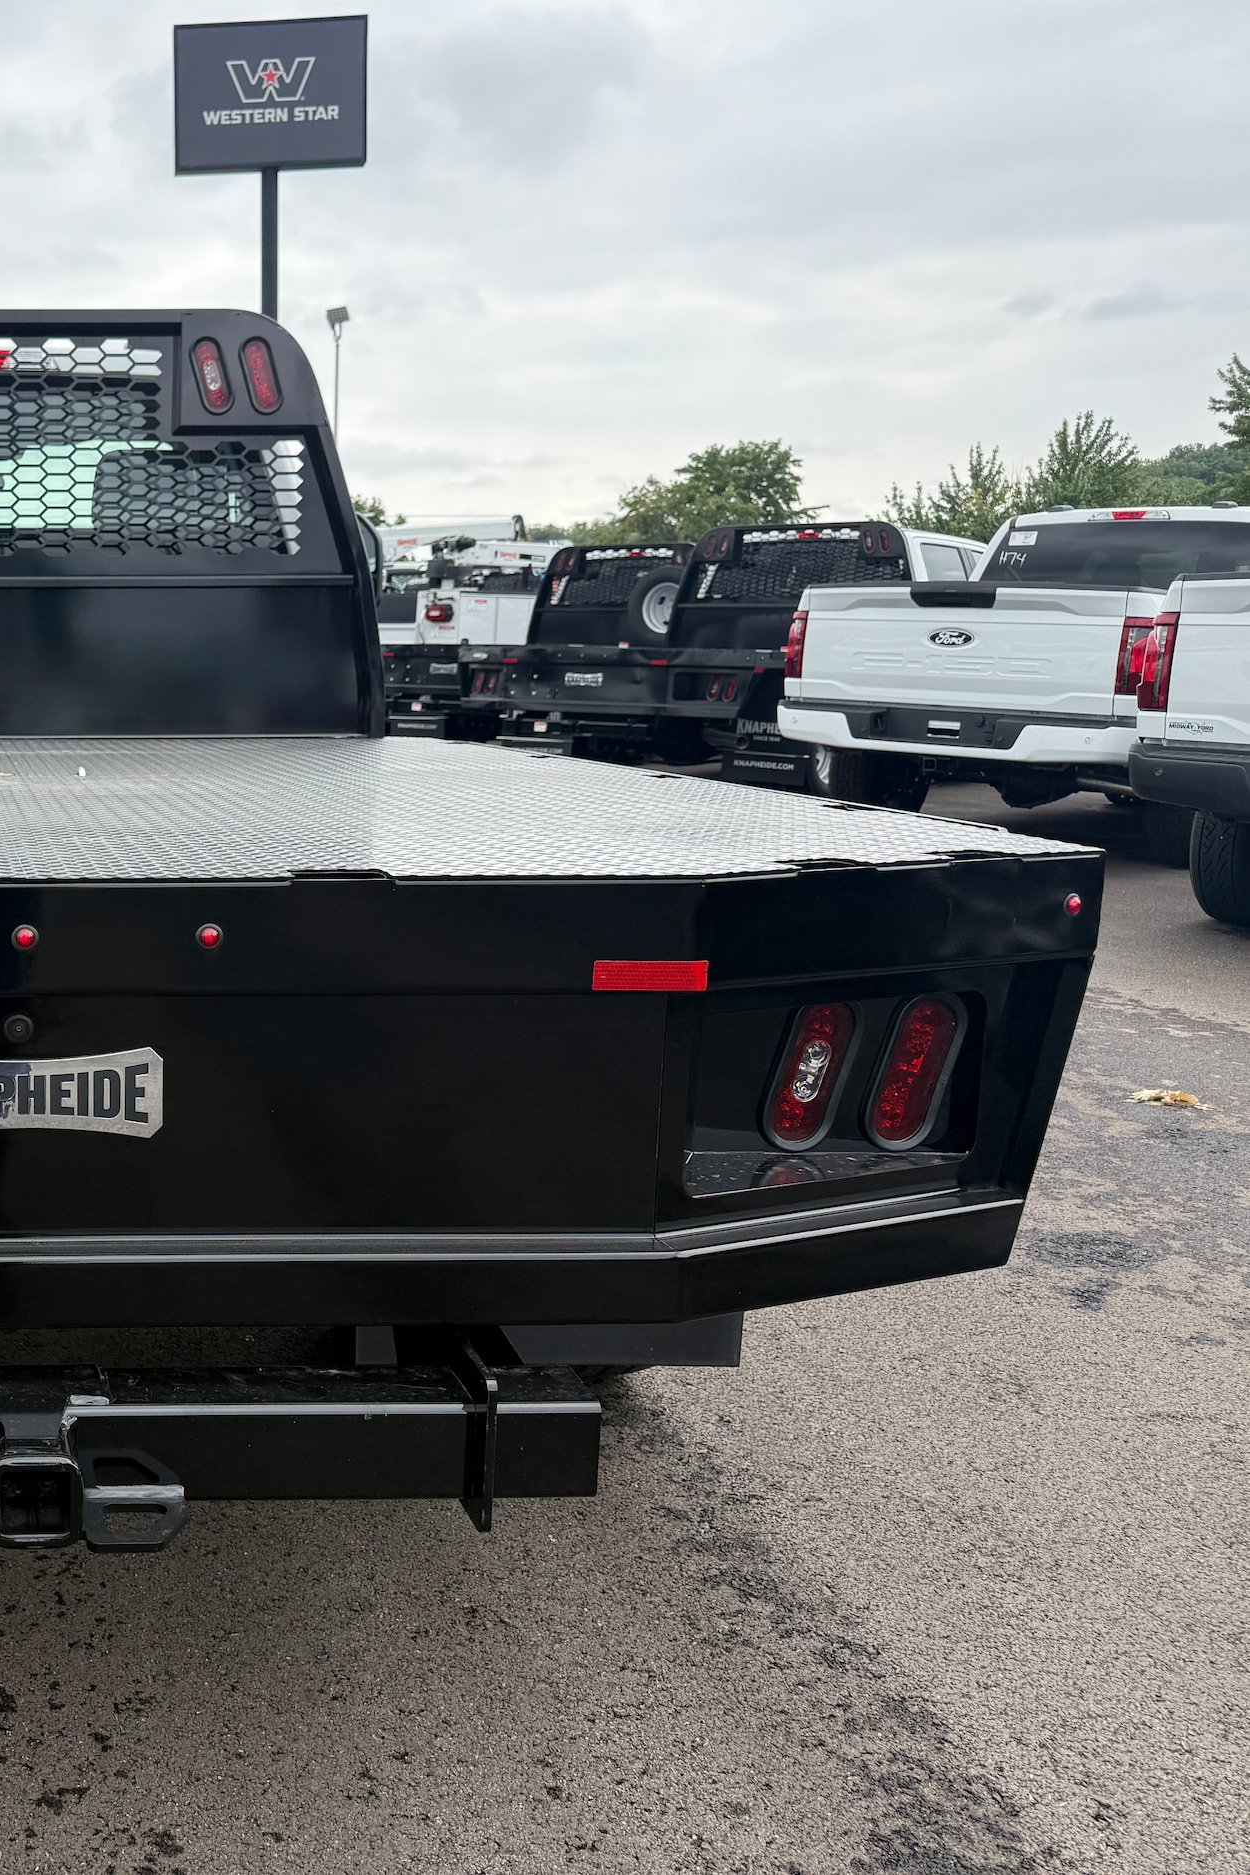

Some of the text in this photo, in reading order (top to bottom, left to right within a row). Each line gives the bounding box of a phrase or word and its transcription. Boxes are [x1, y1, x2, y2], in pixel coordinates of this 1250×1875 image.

[202, 105, 339, 125] WESTERN STAR
[999, 551, 1027, 567] H74
[935, 631, 966, 645] Ford
[736, 718, 781, 735] KNAPHE
[733, 760, 794, 771] KNAPHEIDE.COM
